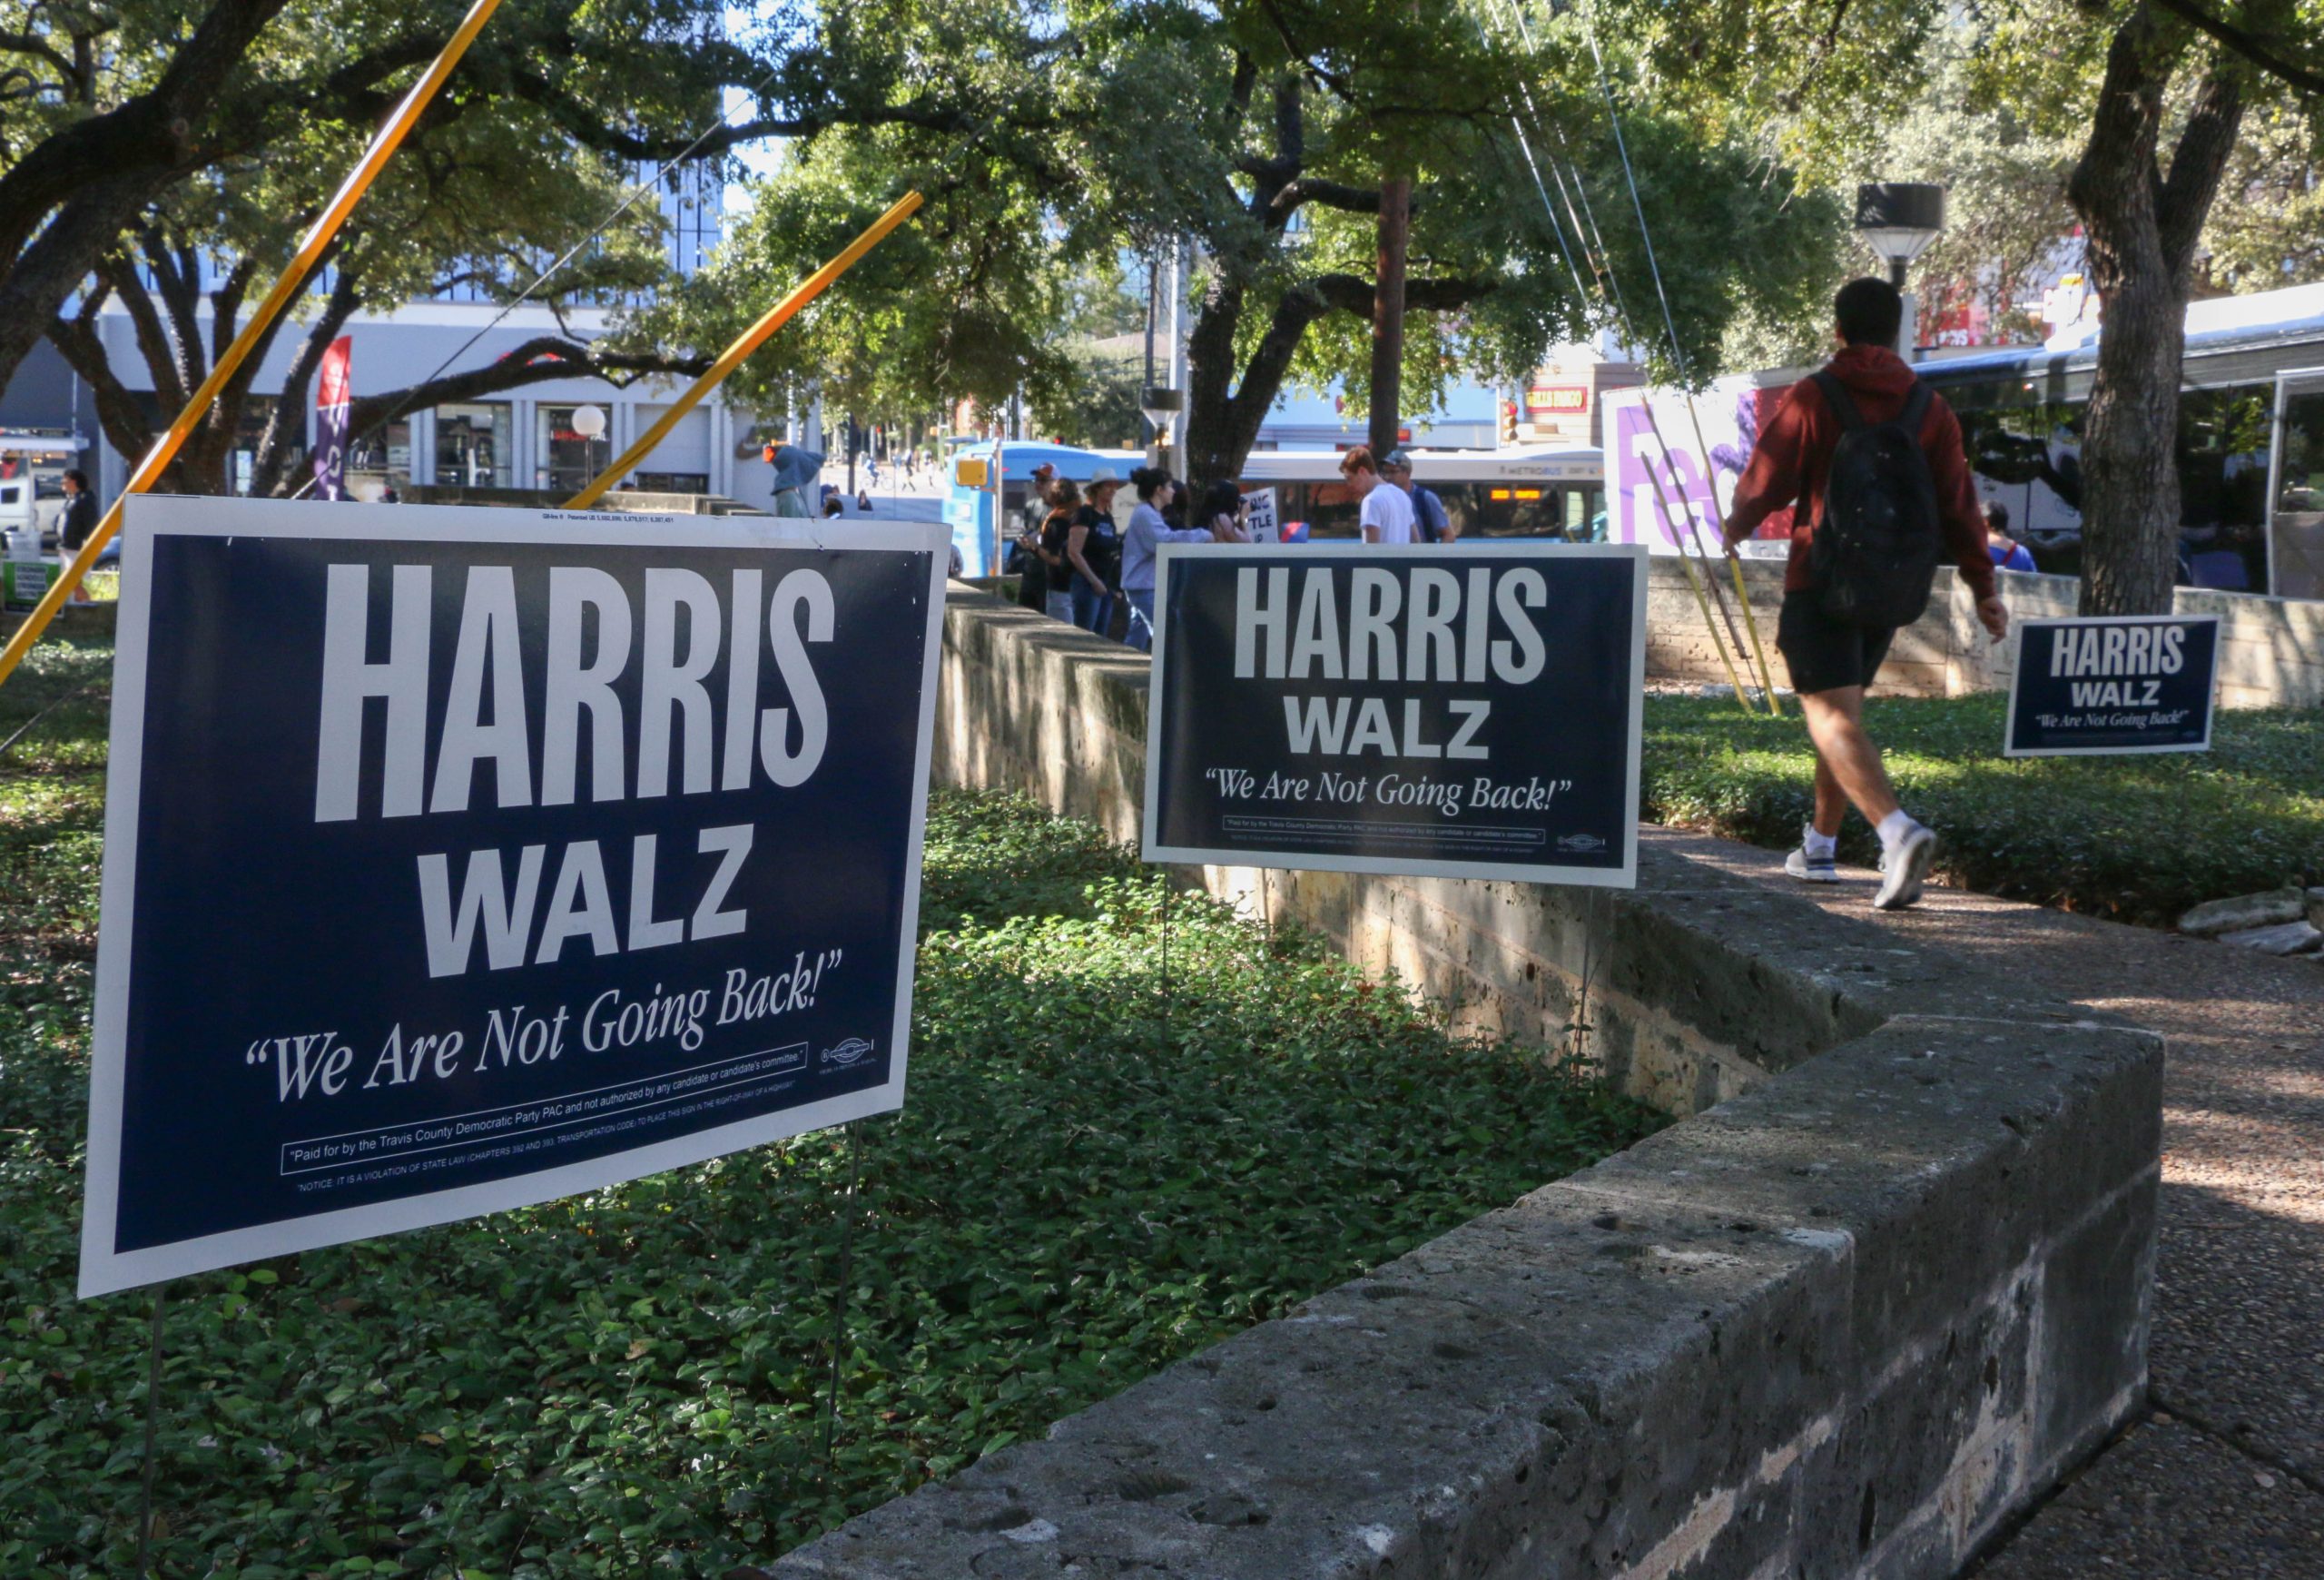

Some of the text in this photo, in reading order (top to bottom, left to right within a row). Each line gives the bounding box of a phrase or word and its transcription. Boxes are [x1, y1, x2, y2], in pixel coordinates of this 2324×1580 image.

[1235, 568, 1547, 685] HARRIS
[2050, 626, 2186, 677] HARRIS
[315, 564, 835, 822] HARRIS
[1283, 696, 1491, 760] WALZ
[2059, 714, 2083, 727] Are
[2083, 713, 2107, 726] Not
[2109, 711, 2148, 730] Going
[2071, 680, 2162, 708] WALZ
[1205, 768, 1572, 816] “We Are Not Going Back!”
[417, 824, 753, 978] WALZ
[246, 948, 843, 1102] “We Are Not Going Back!”
[324, 1145, 340, 1157] for
[342, 1142, 356, 1156] by
[359, 1140, 377, 1151] the
[379, 1133, 412, 1148] Travis
[415, 1126, 453, 1141] County
[456, 1115, 514, 1135] Democratic
[515, 1110, 540, 1125] Party
[543, 1104, 563, 1119] PAC
[565, 1100, 582, 1114] and
[584, 1098, 599, 1111] not
[600, 1088, 644, 1107] authorized
[645, 1086, 655, 1099] by
[656, 1083, 672, 1095] any
[673, 1074, 708, 1090] candidate
[710, 1072, 718, 1081] or
[720, 1061, 761, 1079] candidate's
[337, 1176, 345, 1186] IT
[347, 1174, 355, 1184] IS
[357, 1173, 363, 1181] A
[364, 1165, 408, 1181] VIOLATION
[409, 1162, 420, 1172] OF
[422, 1159, 448, 1171] STATE
[448, 1155, 467, 1166] LAW
[526, 1140, 541, 1150] AND
[557, 1124, 615, 1143] TRANSPORTATION
[638, 1117, 647, 1127] TO
[646, 1111, 667, 1124] PLACE
